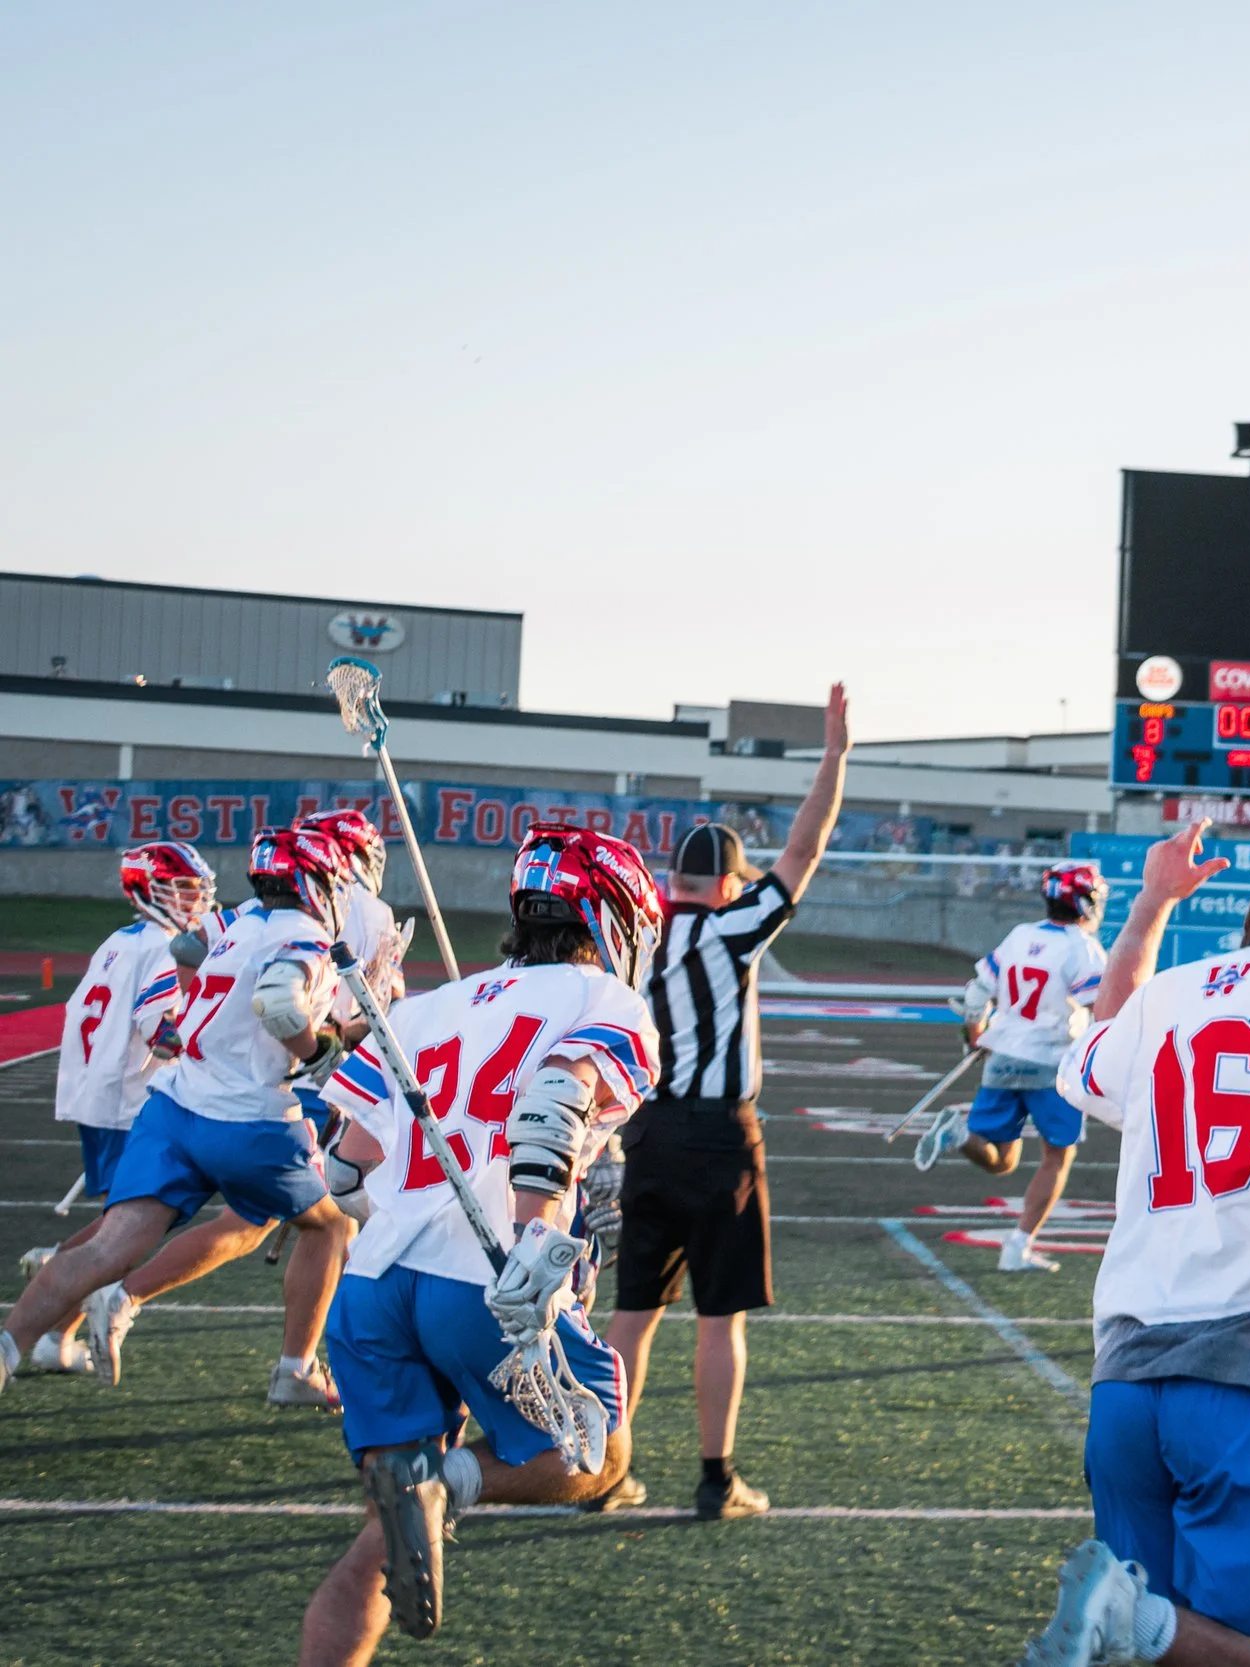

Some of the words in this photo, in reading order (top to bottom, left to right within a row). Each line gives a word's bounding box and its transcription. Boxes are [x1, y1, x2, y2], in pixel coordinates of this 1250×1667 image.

[58, 786, 405, 843] WESTLE
[435, 787, 710, 853] FOOBAL
[1007, 965, 1050, 1022] 17
[400, 1013, 547, 1193] 24
[517, 1112, 549, 1124] STX
